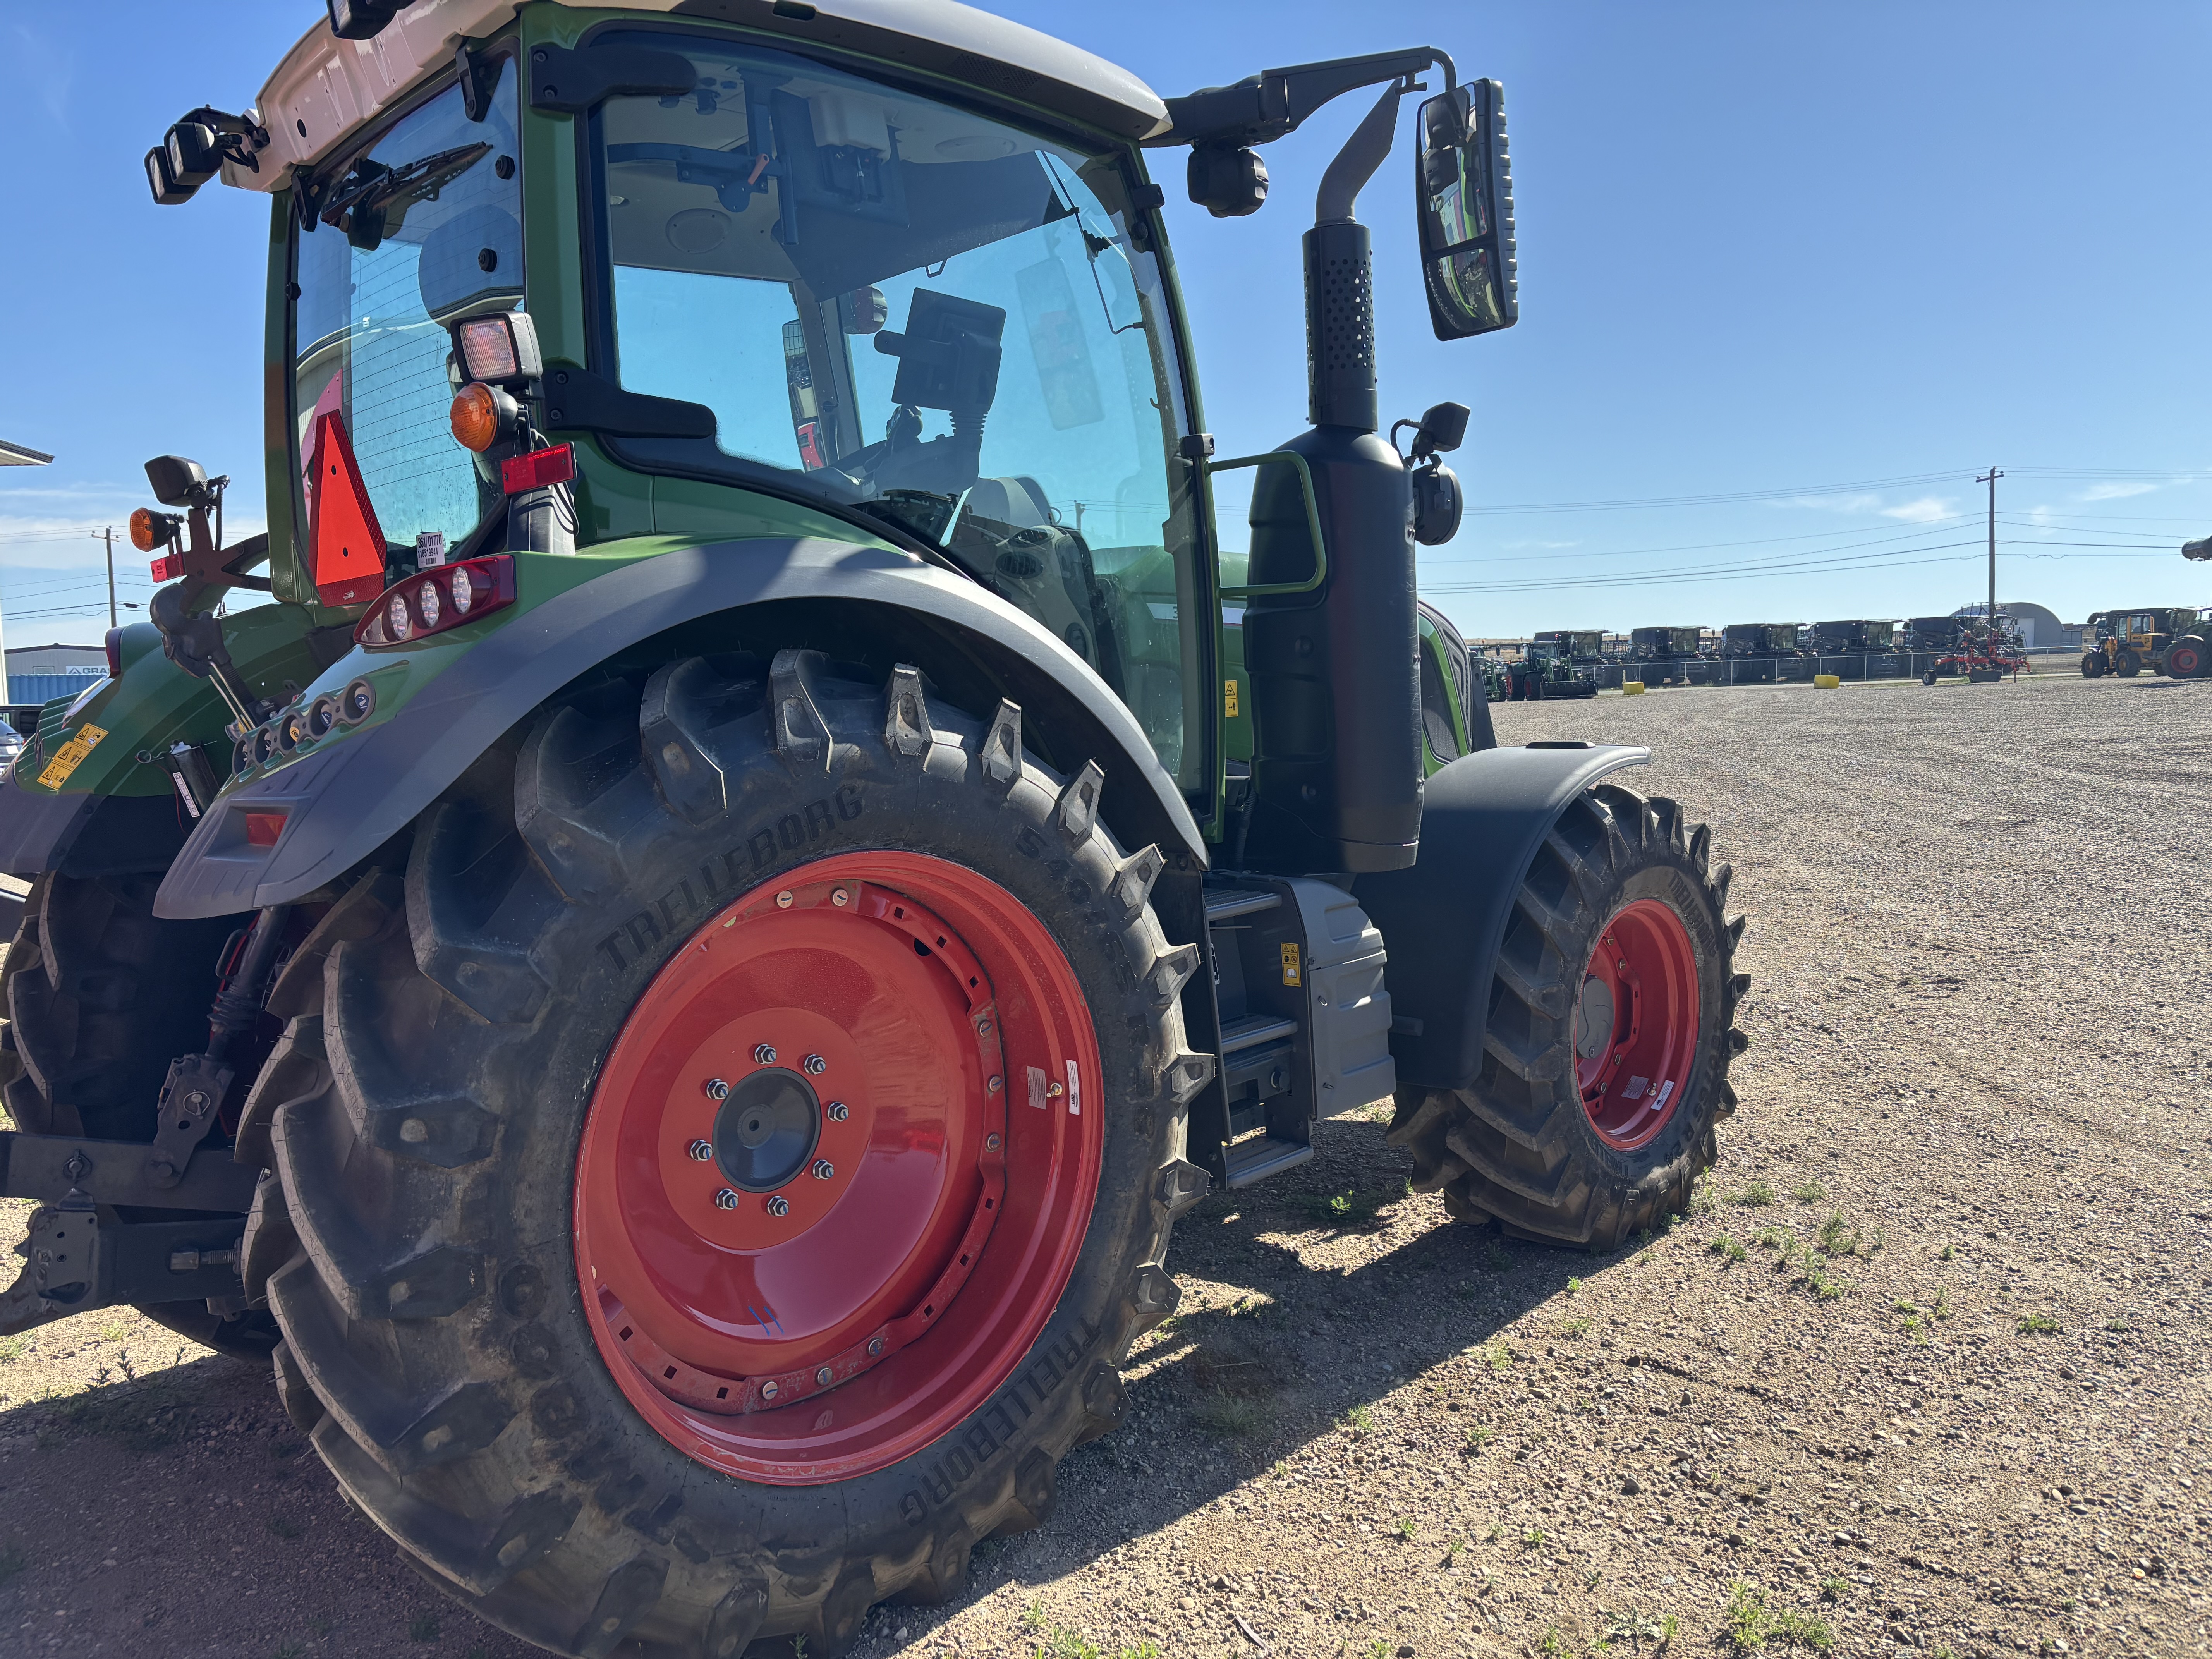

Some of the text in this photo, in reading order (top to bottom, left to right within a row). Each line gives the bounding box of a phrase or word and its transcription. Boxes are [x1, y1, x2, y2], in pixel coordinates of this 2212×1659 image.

[418, 534, 442, 548] 351/01770
[594, 783, 864, 972] TRELLEBORG
[898, 1317, 1102, 1527] TRELLEBORG
